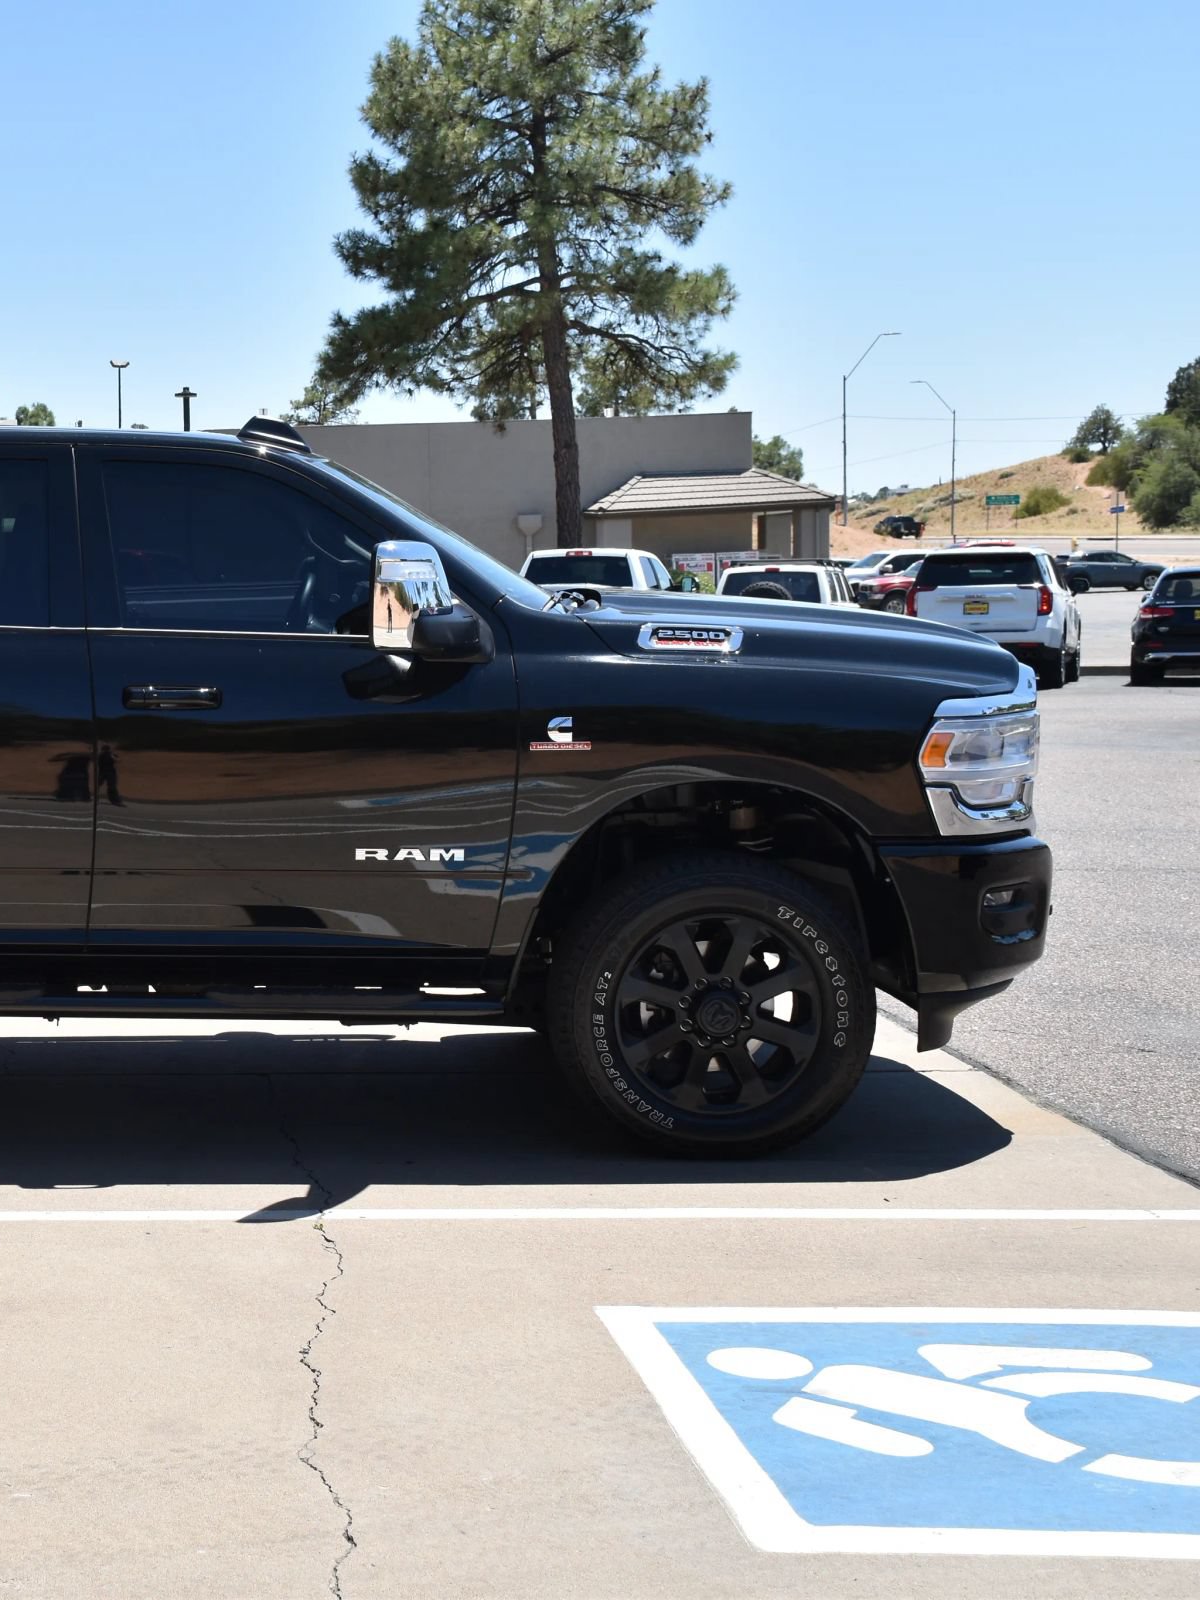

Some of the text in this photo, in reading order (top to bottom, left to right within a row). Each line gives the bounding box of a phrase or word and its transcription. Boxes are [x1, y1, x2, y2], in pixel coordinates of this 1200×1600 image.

[657, 629, 725, 640] 2500
[355, 847, 465, 862] RAM
[777, 905, 849, 1048] Firestone
[592, 1013, 675, 1129] TRANSFORCE
